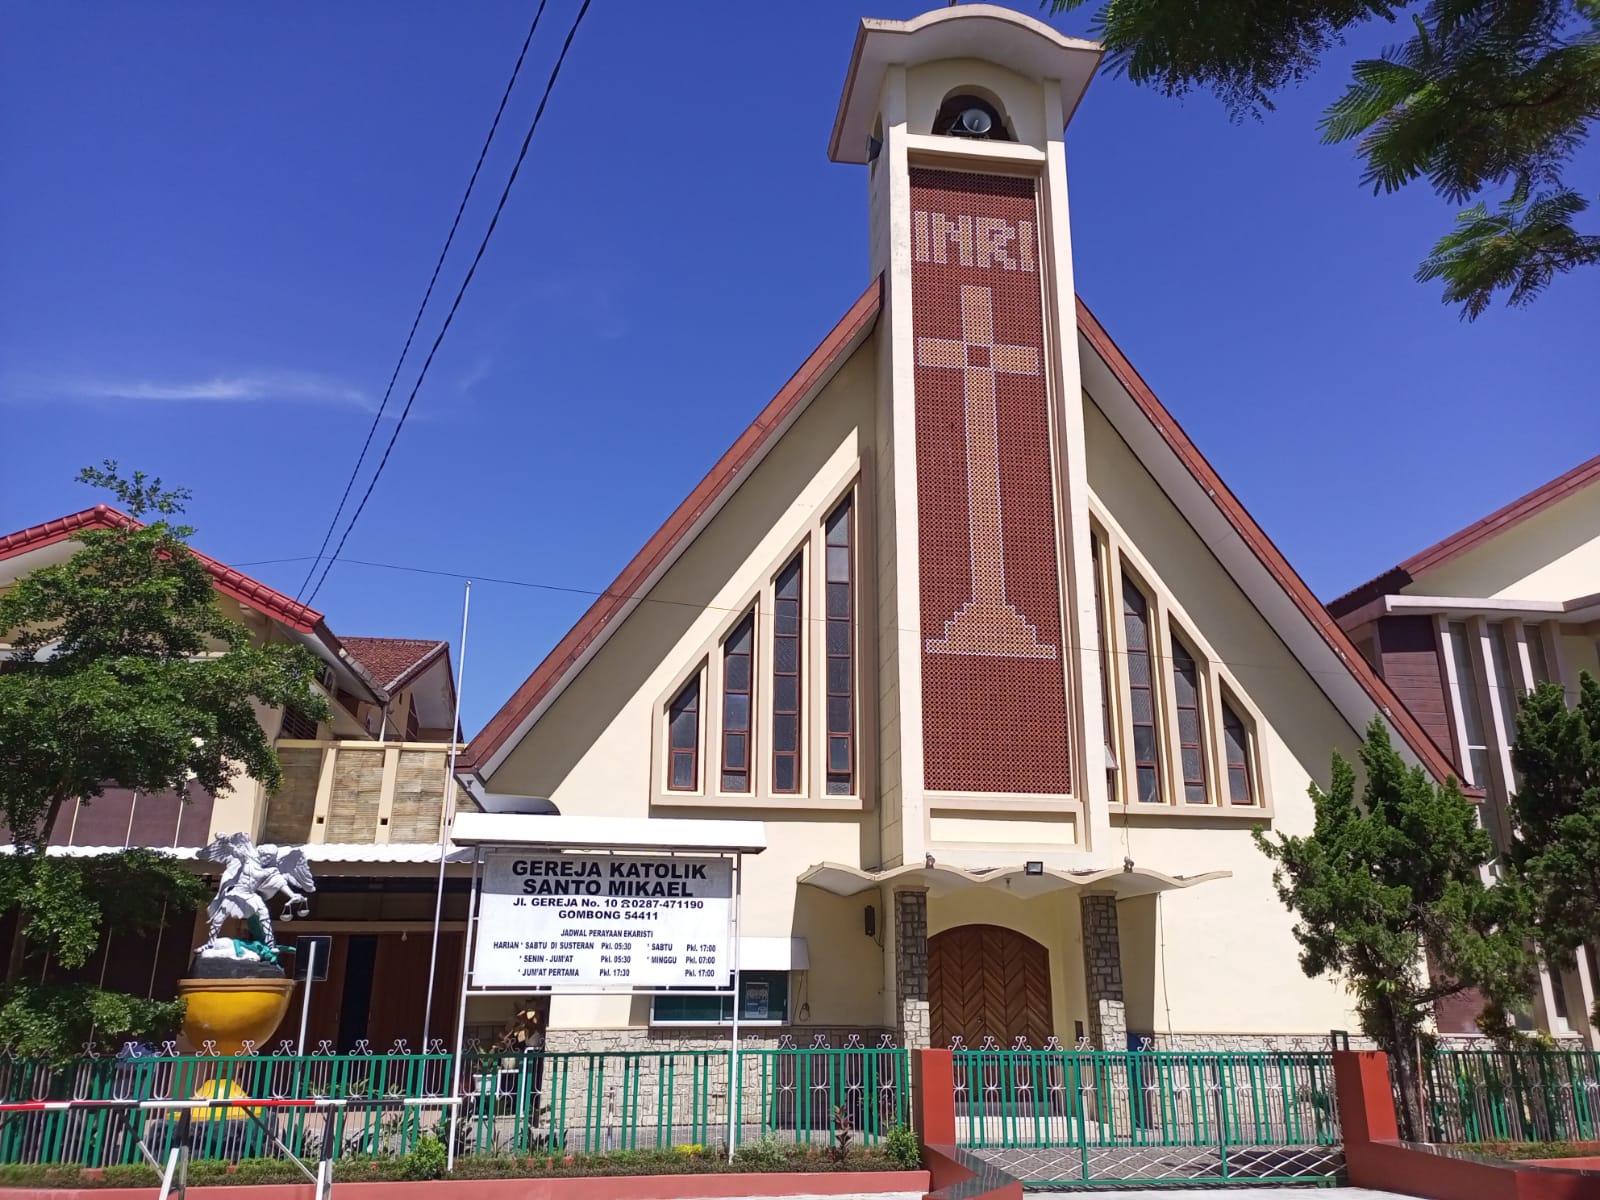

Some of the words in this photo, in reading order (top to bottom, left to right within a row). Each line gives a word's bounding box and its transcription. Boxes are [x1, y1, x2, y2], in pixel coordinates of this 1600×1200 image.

[914, 211, 1034, 272] INRI
[512, 860, 601, 878] GEREJA
[609, 862, 707, 880] KATOLIK
[522, 879, 601, 896] SANTO
[608, 880, 693, 898] MIKAEL
[513, 898, 526, 907] Jl.
[531, 897, 578, 908] GEREJA
[581, 898, 600, 908] No.
[604, 899, 618, 908] 10
[558, 910, 621, 920] GOMBONG
[624, 911, 658, 921] 54411
[560, 929, 587, 937] JADWAL
[588, 929, 622, 938] PERAYAAN
[624, 930, 654, 938] EKARISTI
[493, 942, 519, 950] HARIAN
[525, 942, 547, 950] SABTU
[560, 942, 594, 950] SUSTERAN
[601, 942, 612, 950] Pkl.
[614, 942, 632, 950] 05:30
[652, 943, 673, 951] SABTU
[686, 944, 698, 952] Pkl.
[700, 944, 716, 952] 17:00
[524, 955, 544, 963] SENIN
[600, 956, 612, 964] Pkl.
[614, 956, 631, 964] 05:30
[651, 956, 677, 964] MINGGU
[686, 956, 697, 964] Pkl.
[698, 956, 716, 964] 07:00
[548, 968, 580, 976] PERTAMA
[600, 968, 611, 977] Pkl.
[614, 968, 630, 977] 17:30
[684, 969, 696, 978] Pkl.
[698, 969, 715, 978] 17:00
